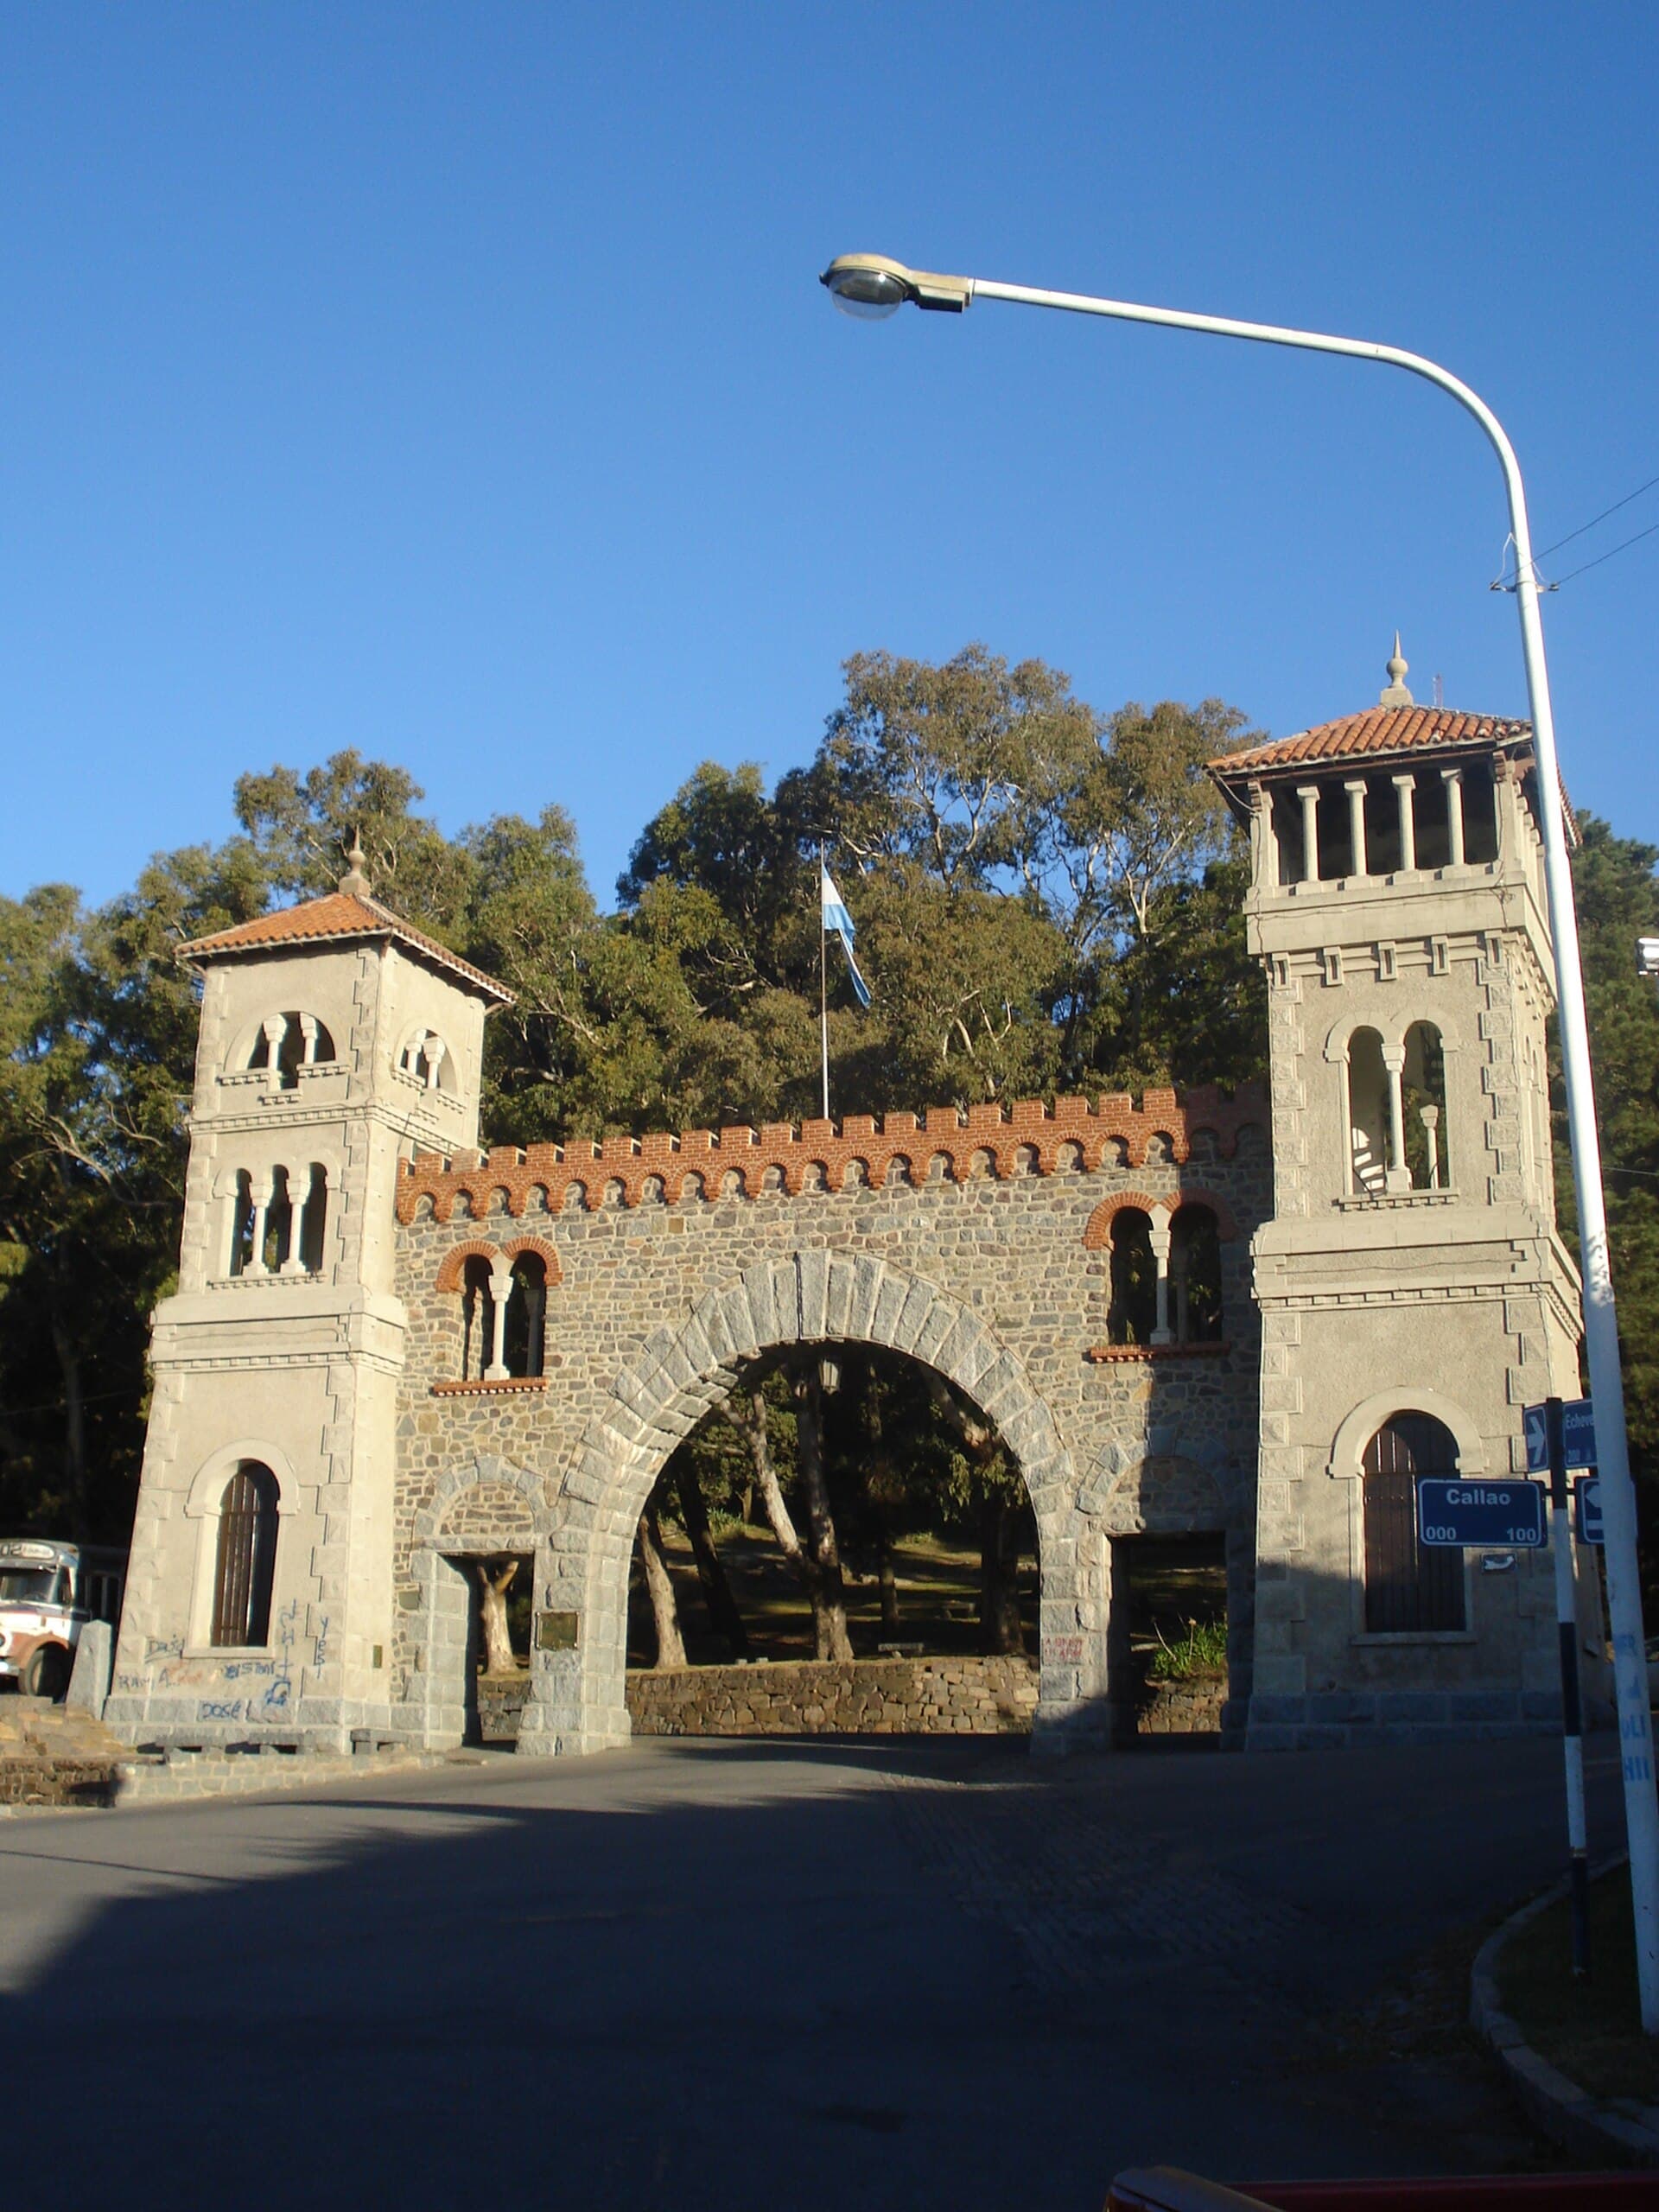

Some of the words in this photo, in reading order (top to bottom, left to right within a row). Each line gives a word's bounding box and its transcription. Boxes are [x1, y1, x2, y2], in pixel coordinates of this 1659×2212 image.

[1446, 1488, 1511, 1505] Callao
[1426, 1526, 1457, 1541] 000
[1506, 1528, 1536, 1541] 100
